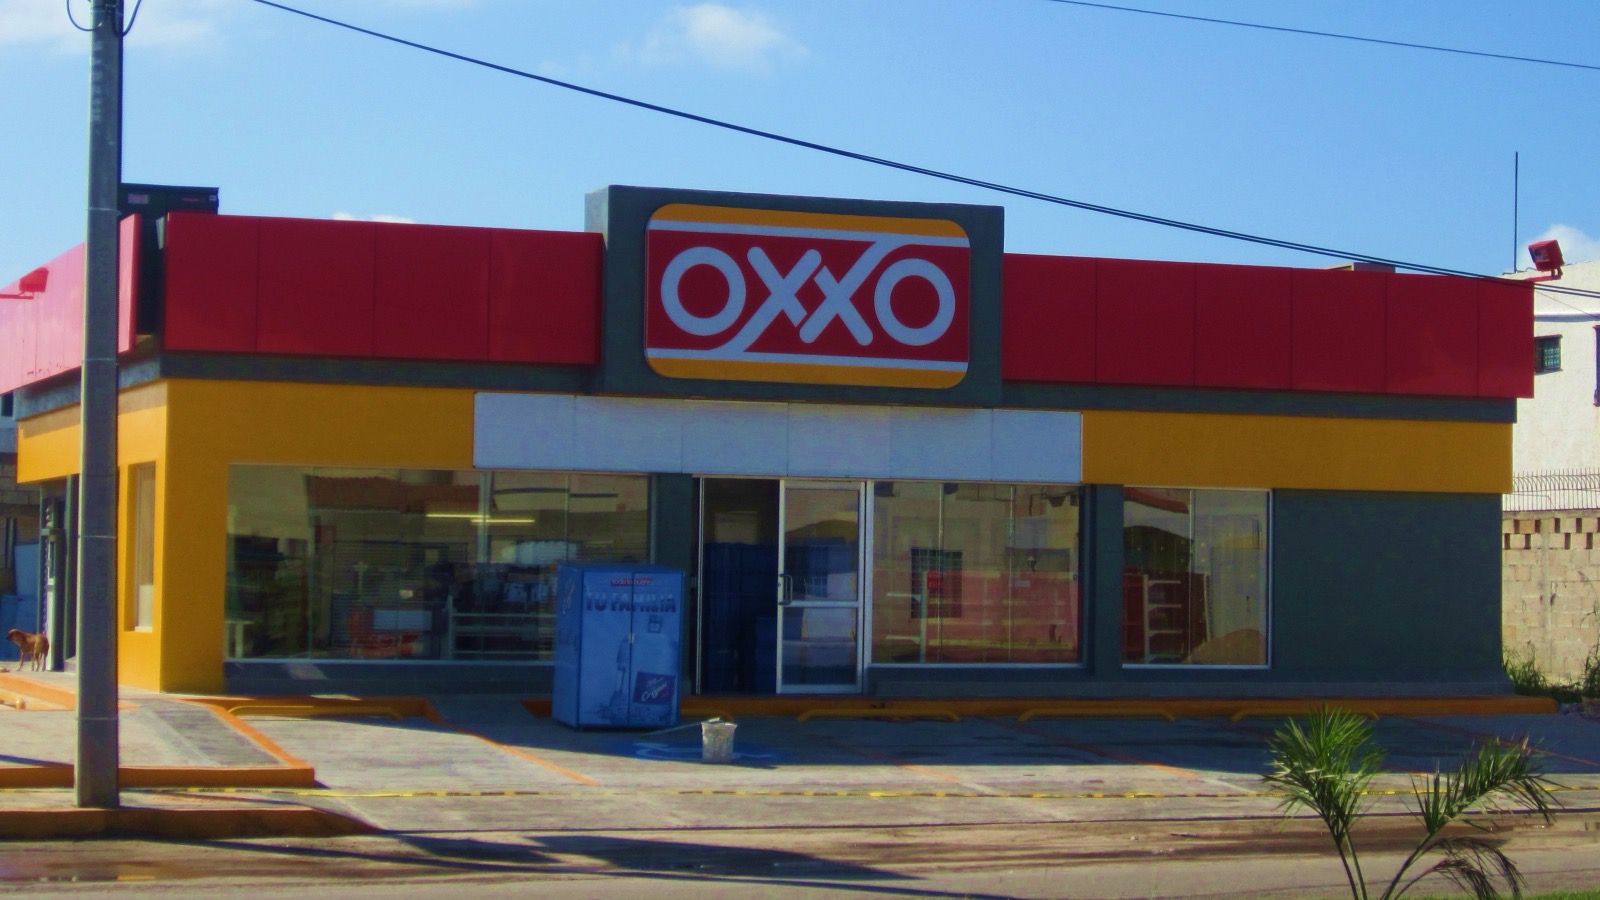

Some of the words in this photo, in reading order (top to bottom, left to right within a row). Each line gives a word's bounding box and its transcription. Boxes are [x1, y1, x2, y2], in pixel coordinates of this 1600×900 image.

[660, 242, 956, 350] OXXO
[586, 592, 606, 611] TU
[610, 592, 676, 613] FAMILIA
